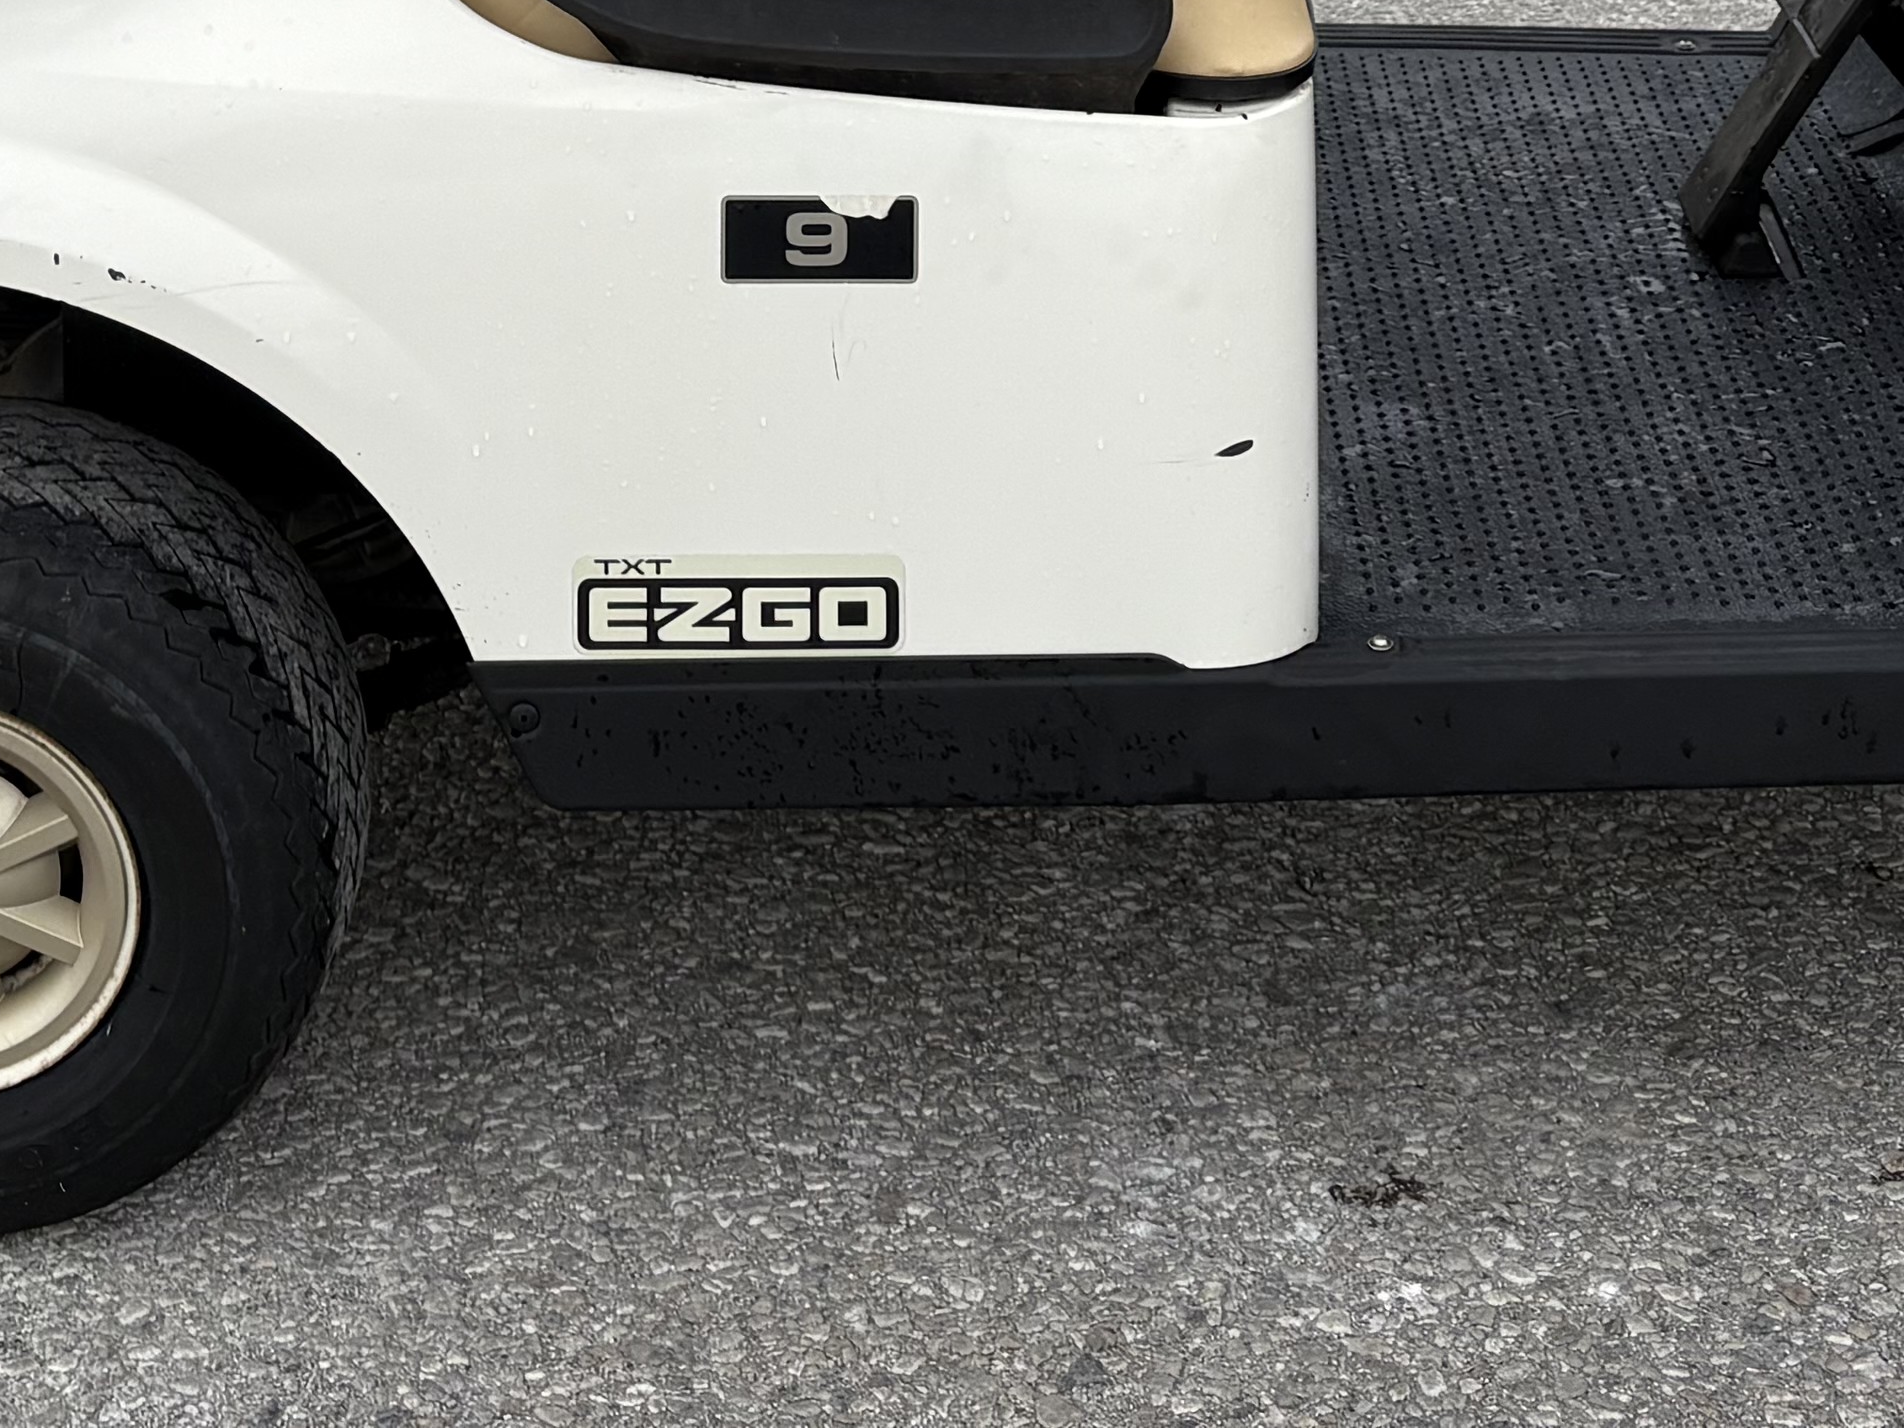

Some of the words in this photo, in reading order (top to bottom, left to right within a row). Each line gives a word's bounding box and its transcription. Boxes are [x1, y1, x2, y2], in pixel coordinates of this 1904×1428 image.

[784, 213, 848, 267] 9
[594, 559, 672, 575] TXT
[588, 586, 887, 643] EZGO
